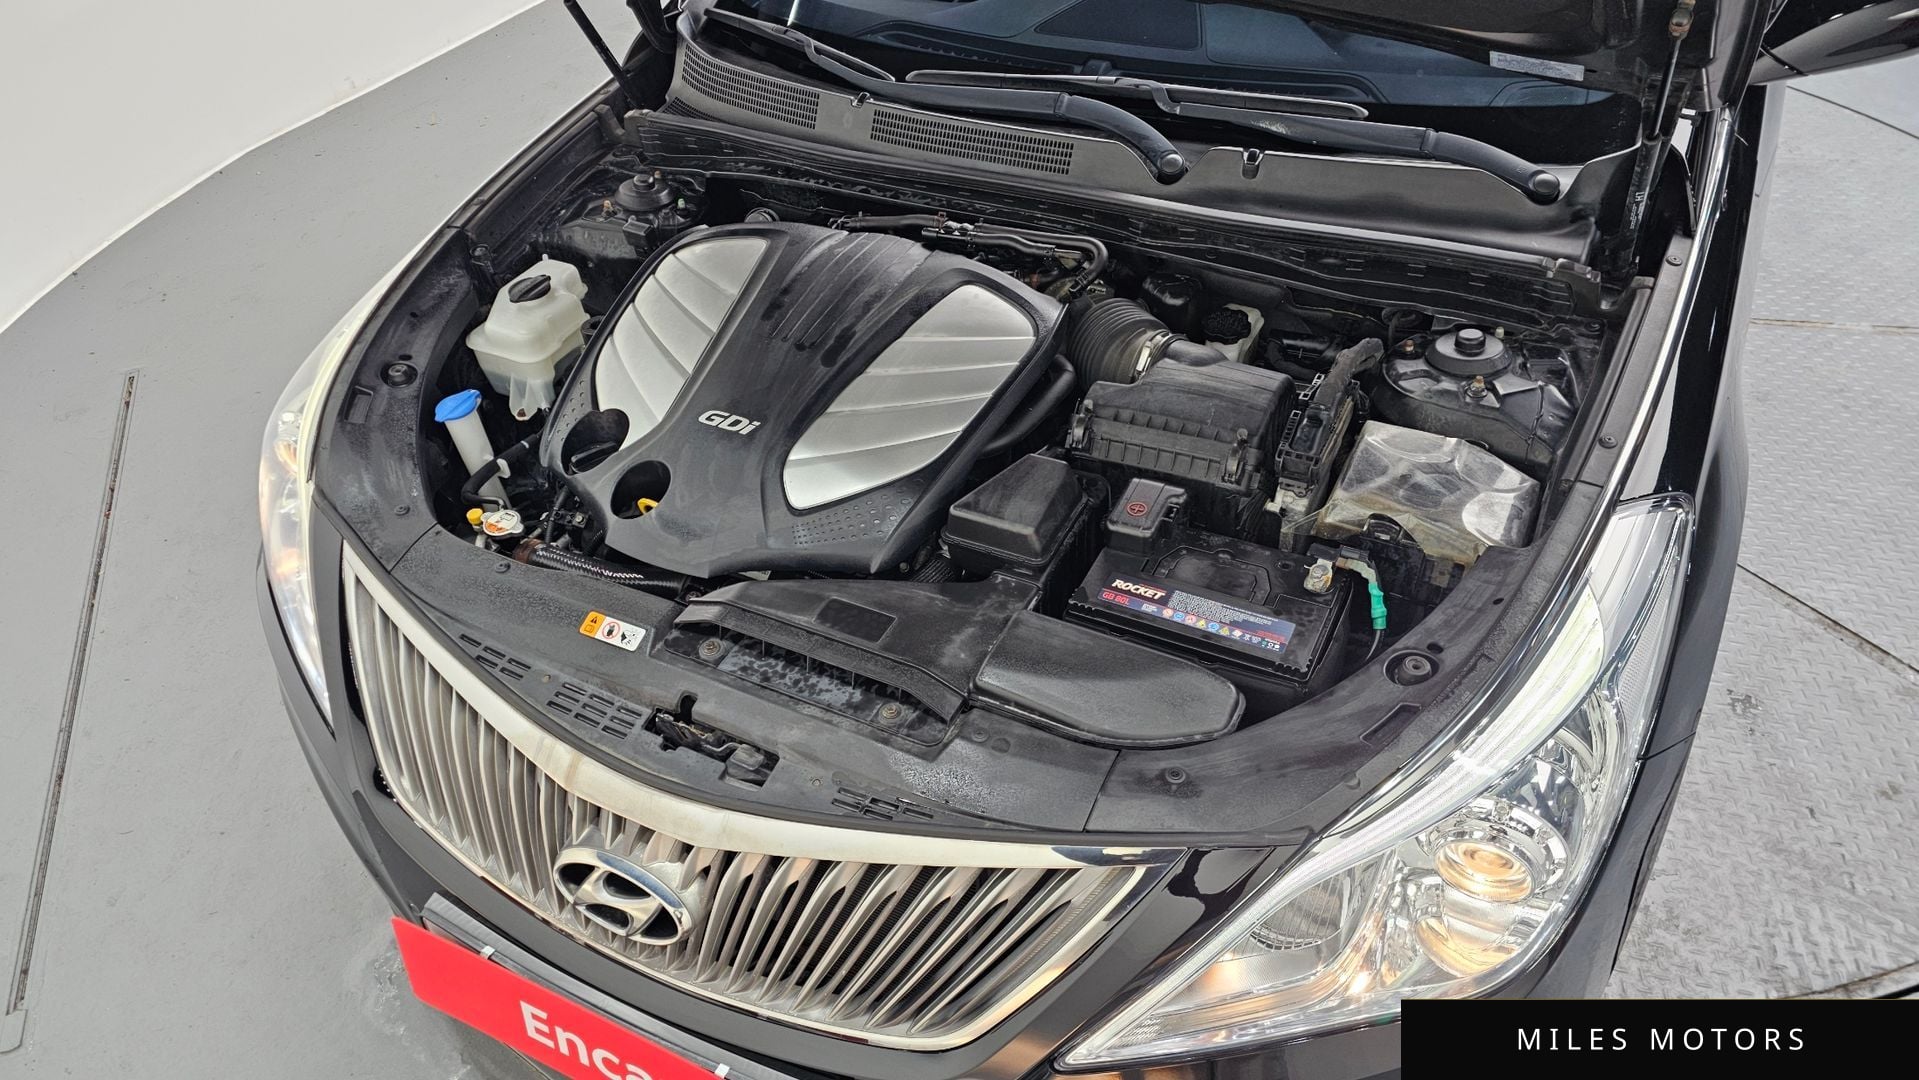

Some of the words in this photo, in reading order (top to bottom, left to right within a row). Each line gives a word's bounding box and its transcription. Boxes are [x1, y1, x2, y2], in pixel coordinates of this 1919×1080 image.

[698, 410, 761, 435] GDi
[1102, 591, 1115, 600] GB
[1112, 579, 1166, 600] ROCKET
